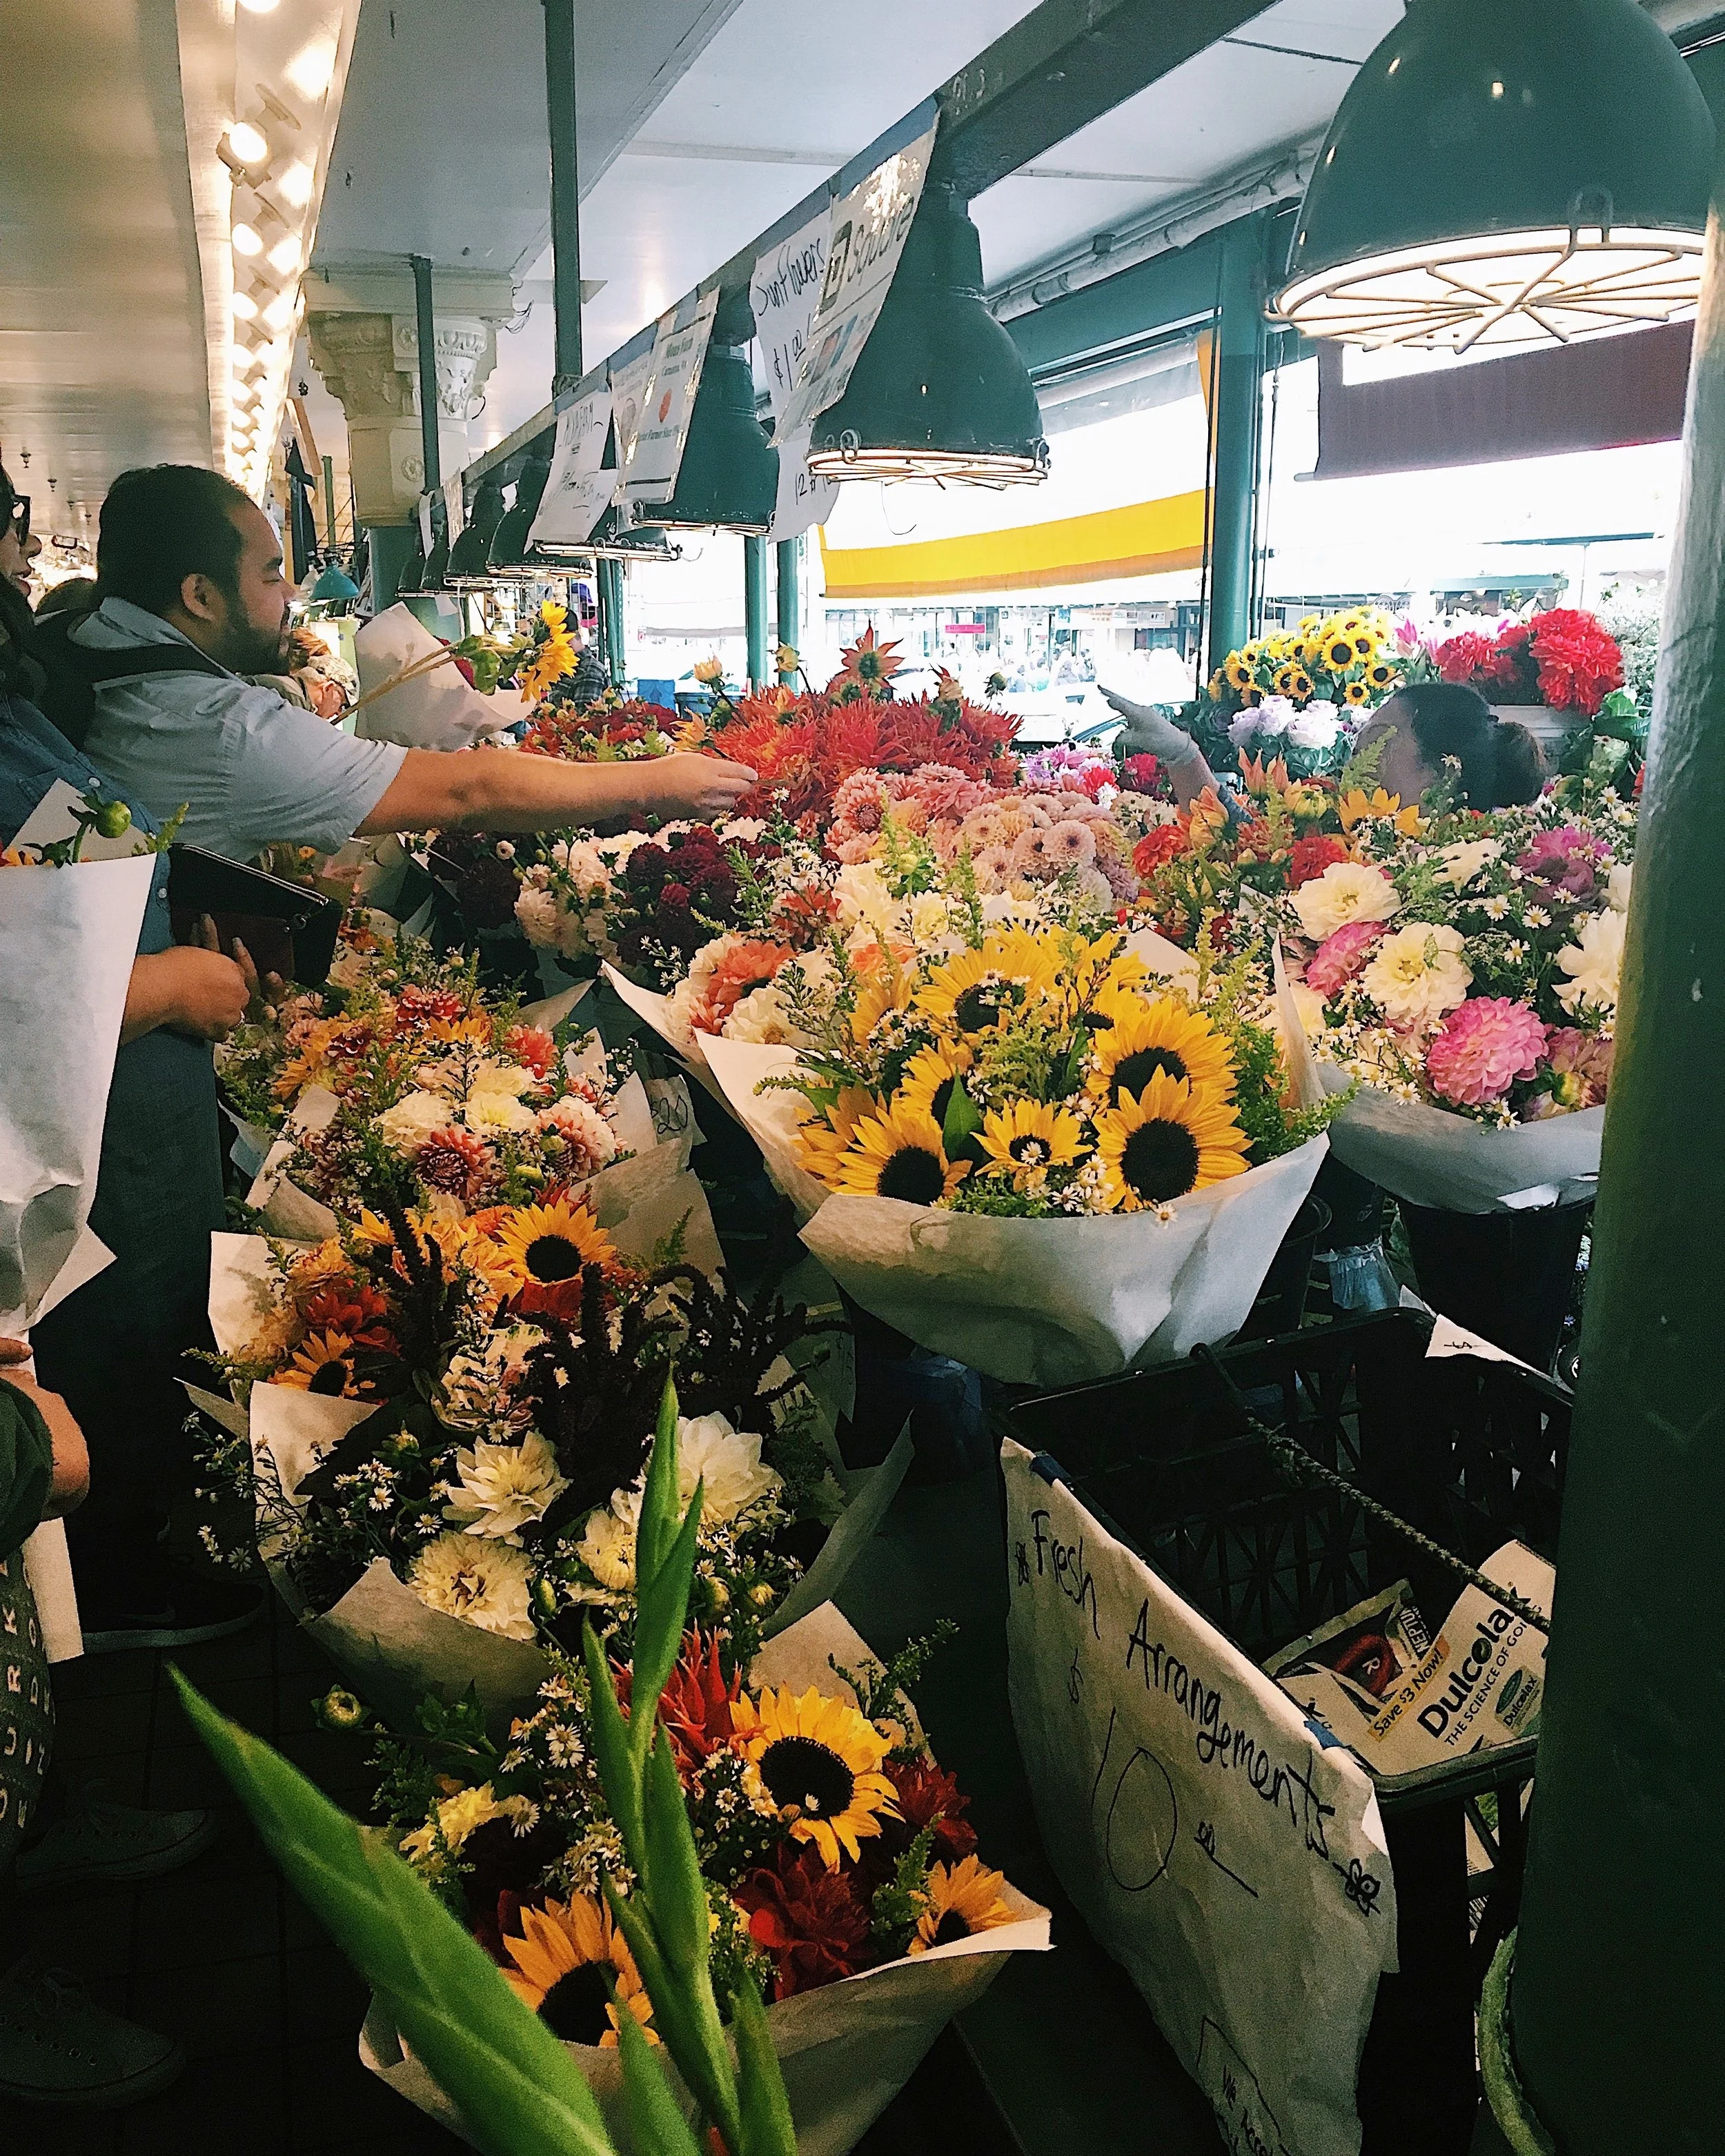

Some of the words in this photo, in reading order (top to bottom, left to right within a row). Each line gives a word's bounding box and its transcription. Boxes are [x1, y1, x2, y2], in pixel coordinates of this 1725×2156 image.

[756, 238, 825, 316] Sunflowers
[1031, 1510, 1101, 1641] Fresh
[1126, 1598, 1336, 1860] Arrangements
[1373, 1703, 1403, 1737] Save
[1399, 1687, 1415, 1704] $3
[1412, 1648, 1444, 1690] Now!
[1417, 1608, 1515, 1739] Dulcola
[1444, 1721, 1467, 1746] THE
[1463, 1667, 1500, 1723] SCIENCE
[1496, 1646, 1510, 1668] OF
[1507, 1622, 1528, 1647] GOI
[1503, 1674, 1537, 1726] Dulcolax
